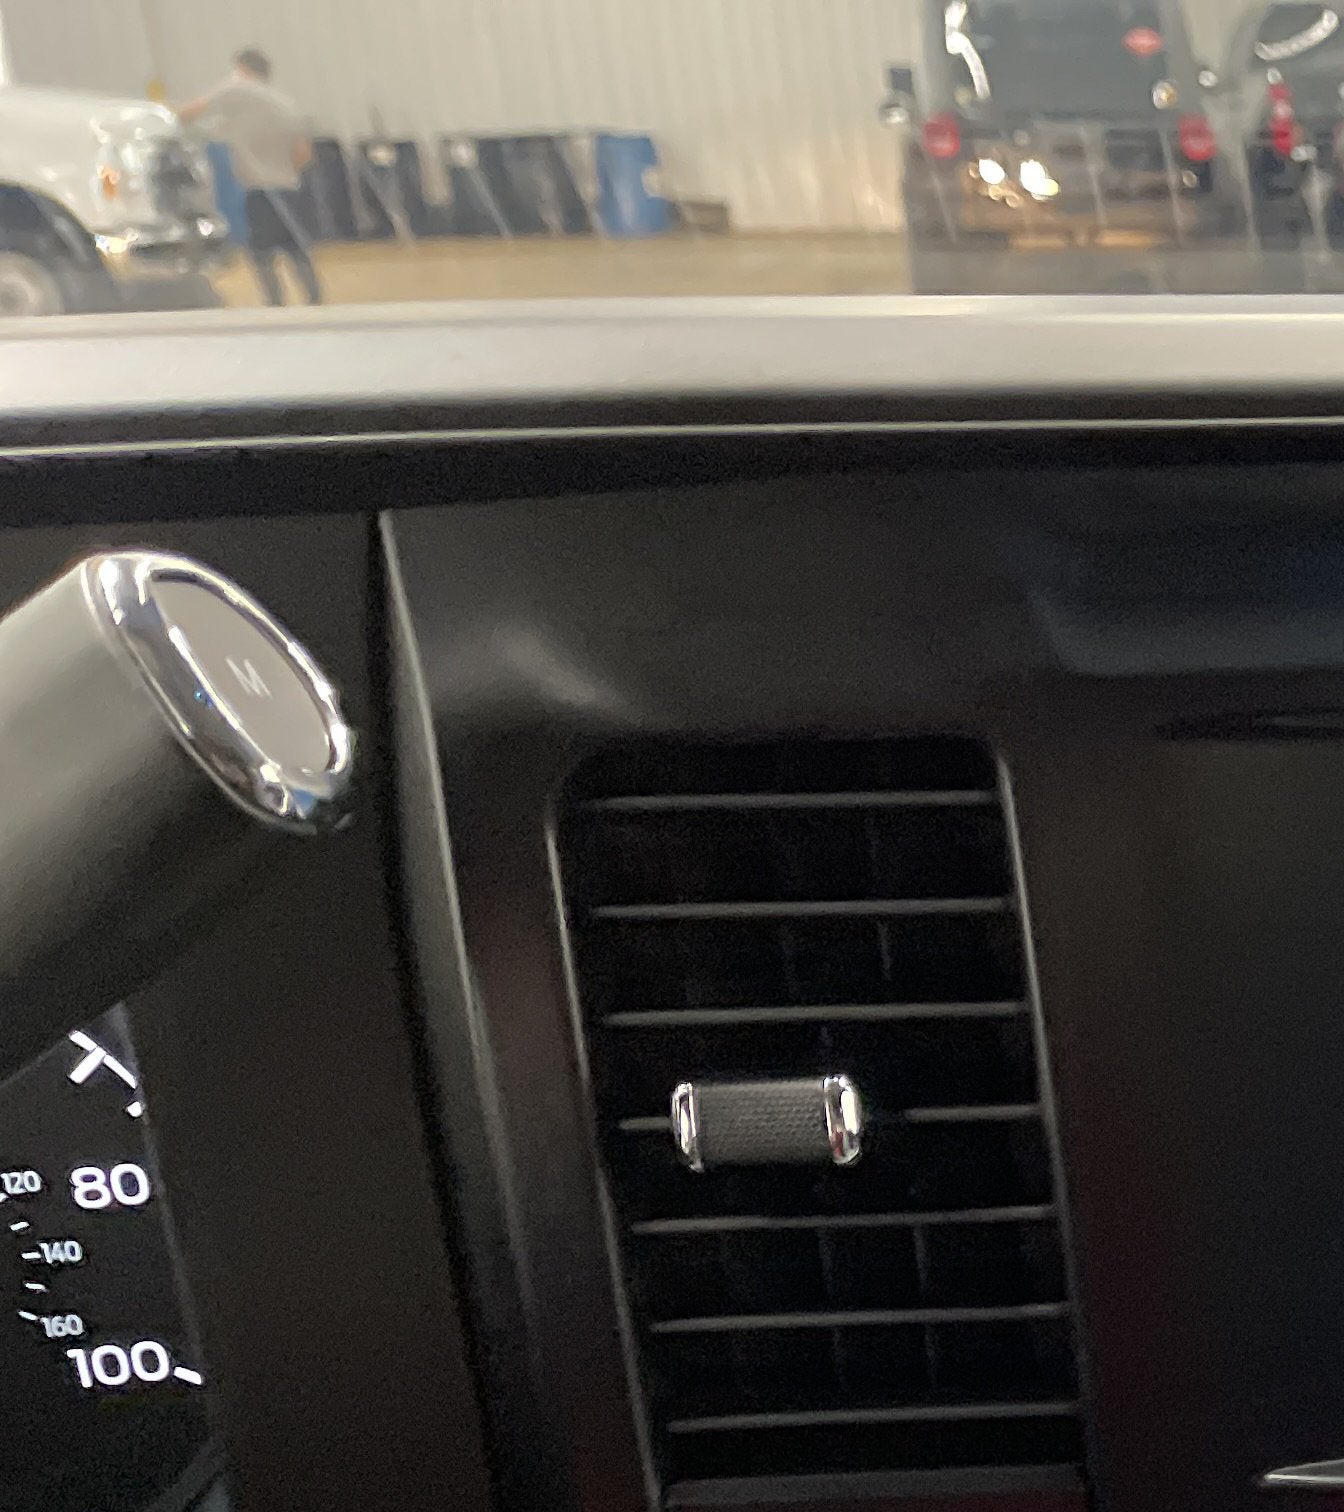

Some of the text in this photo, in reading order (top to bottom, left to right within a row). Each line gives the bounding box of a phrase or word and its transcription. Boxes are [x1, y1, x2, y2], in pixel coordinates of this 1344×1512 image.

[3, 1169, 42, 1195] 120
[70, 1164, 149, 1208] 80
[40, 1241, 83, 1264] 140
[42, 1313, 85, 1338] 160
[67, 1341, 169, 1388] 100
